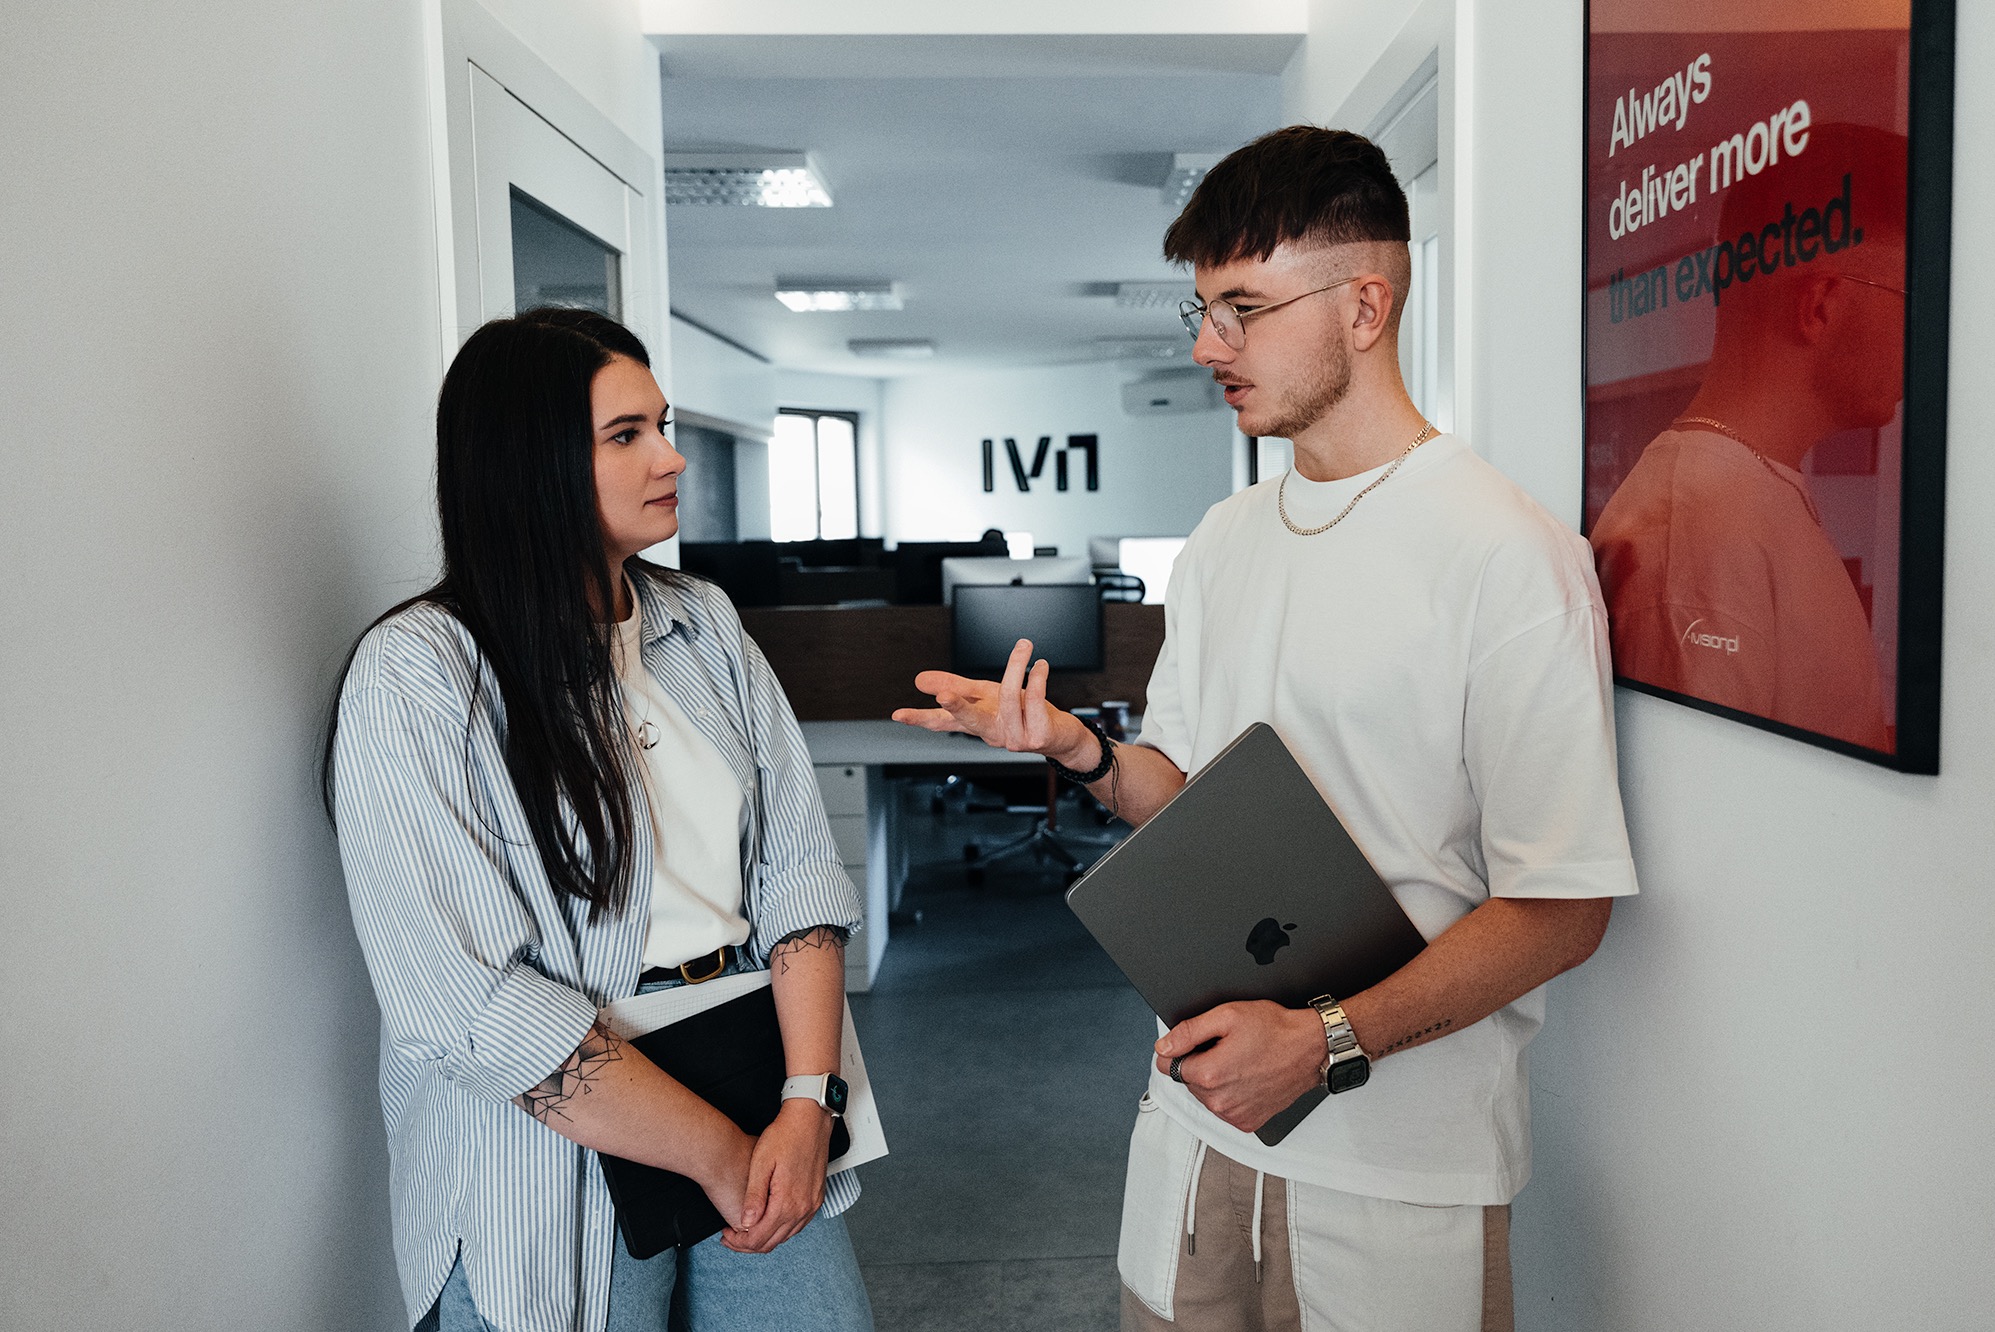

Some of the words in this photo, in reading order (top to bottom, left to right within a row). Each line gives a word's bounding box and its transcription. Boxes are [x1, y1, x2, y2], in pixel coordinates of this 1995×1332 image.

[1608, 52, 1712, 158] Always
[1608, 152, 1704, 241] deliver
[1709, 99, 1812, 195] more
[1608, 264, 1668, 325] than
[1674, 172, 1864, 307] expected.
